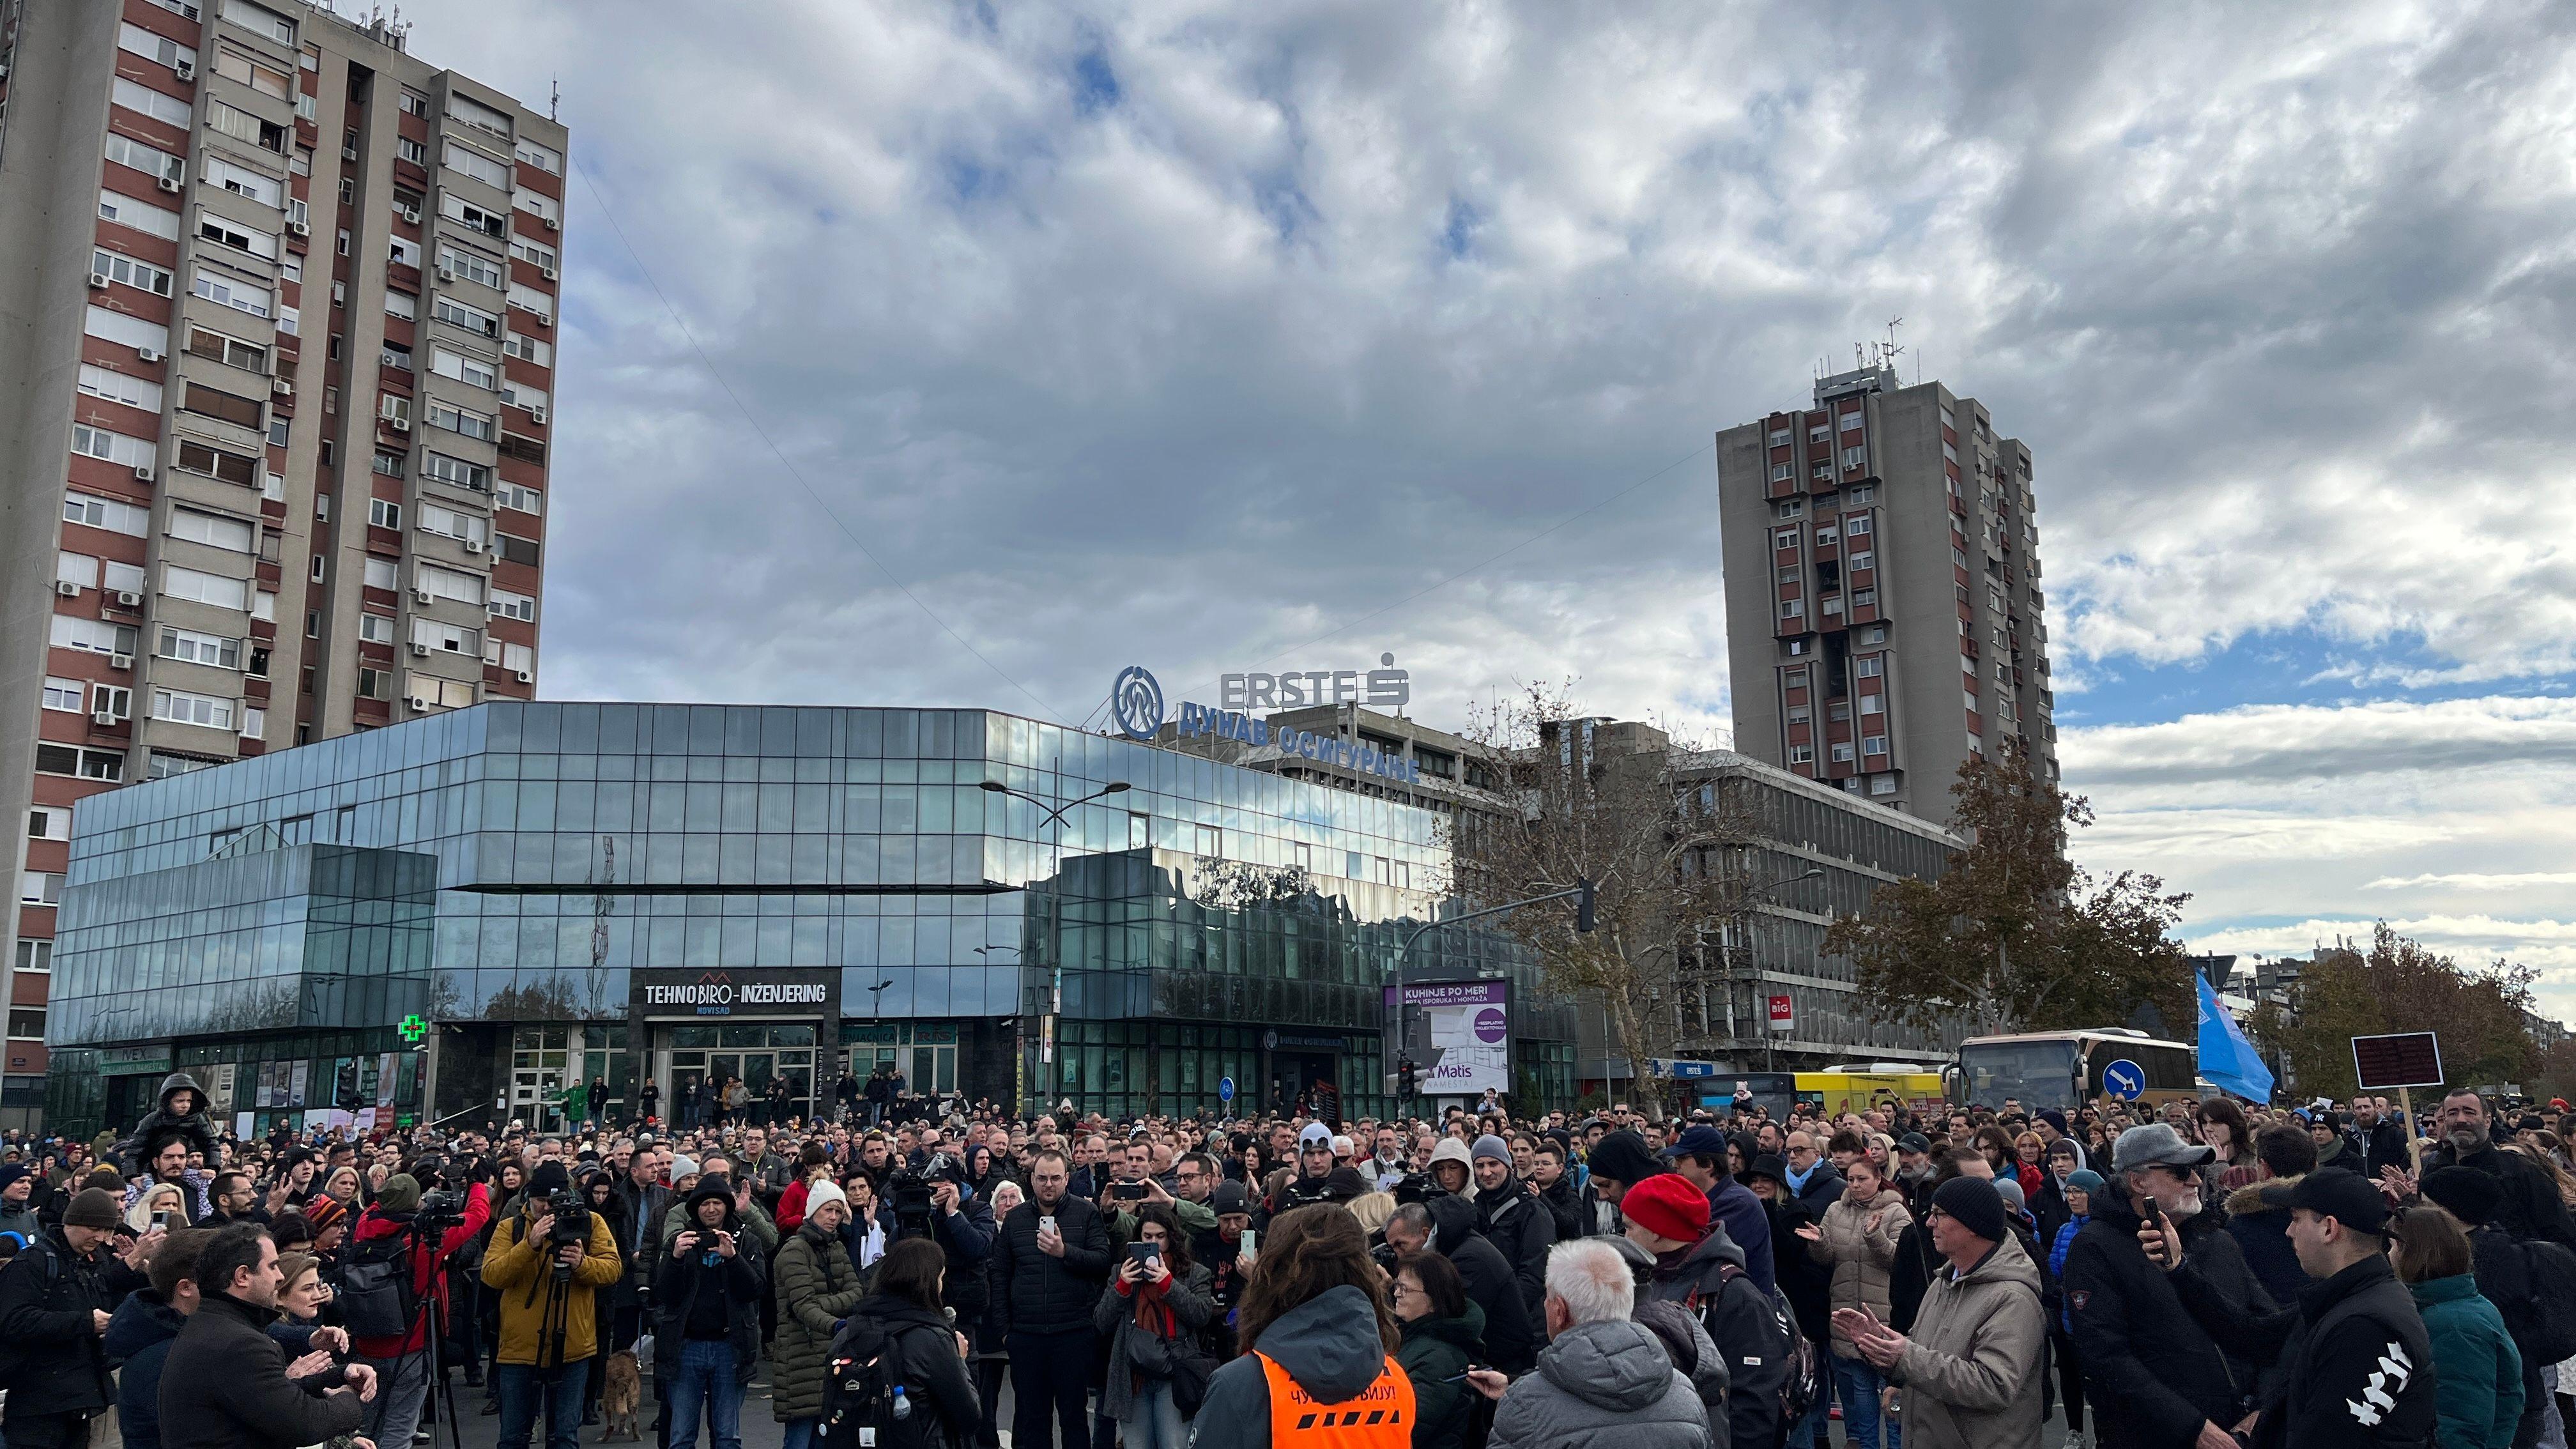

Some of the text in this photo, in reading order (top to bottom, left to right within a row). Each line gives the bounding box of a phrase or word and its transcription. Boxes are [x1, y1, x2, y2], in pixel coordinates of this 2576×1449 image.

[1221, 671, 1356, 709] ERSTE
[1177, 701, 1420, 784] ДУНАВ ОСИГУРАЊЕ
[1406, 985, 1488, 999] KUHINJE PO MERI
[1423, 997, 1453, 1005] ISPORUKA
[1458, 994, 1488, 1002] MONTAŽA
[1438, 1064, 1472, 1078] Matis
